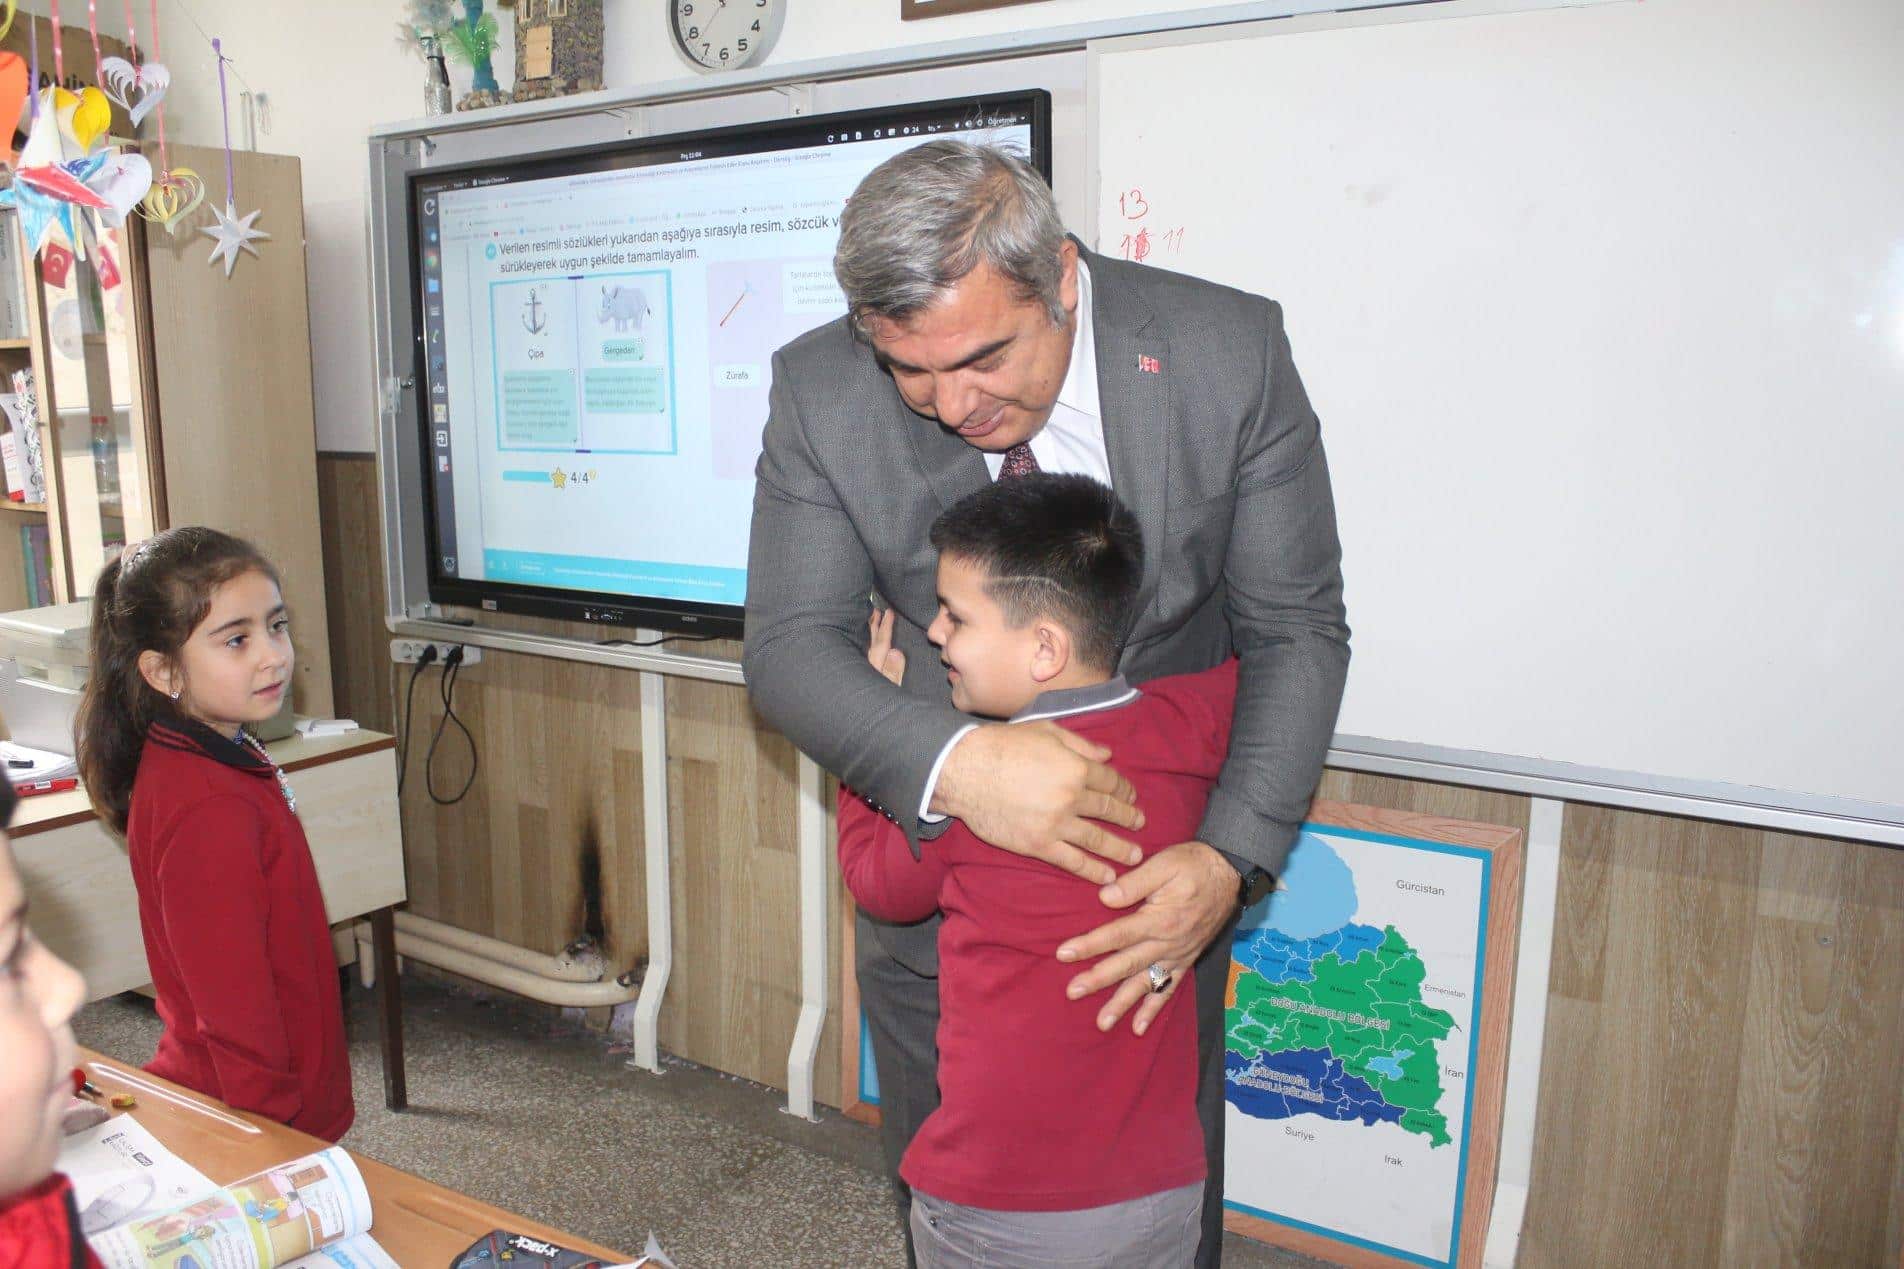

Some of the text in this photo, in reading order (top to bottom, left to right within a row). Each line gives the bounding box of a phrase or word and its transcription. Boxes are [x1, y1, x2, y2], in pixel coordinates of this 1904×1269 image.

[683, 4, 693, 16] 9
[750, 19, 761, 32] 4
[688, 26, 699, 39] 8
[702, 43, 710, 55] 7
[737, 38, 748, 51] 5
[719, 47, 729, 60] 6
[1119, 189, 1148, 220] 13
[500, 242, 530, 255] Verilen
[532, 239, 561, 252] resimli
[564, 235, 608, 250] sözlükleri
[611, 230, 659, 248] yukarıdan
[661, 227, 701, 243] aşağıya
[704, 222, 747, 240] sırasıyla
[751, 220, 785, 234] resim,
[788, 216, 829, 231] sözcük
[500, 247, 699, 274] sürükleyerek uygun şekilde tamamlayalım.
[571, 471, 589, 484] 4/4
[1396, 879, 1445, 896] Gürcistan
[1424, 983, 1466, 999] Ermenistan
[1285, 1126, 1315, 1142] Suriye
